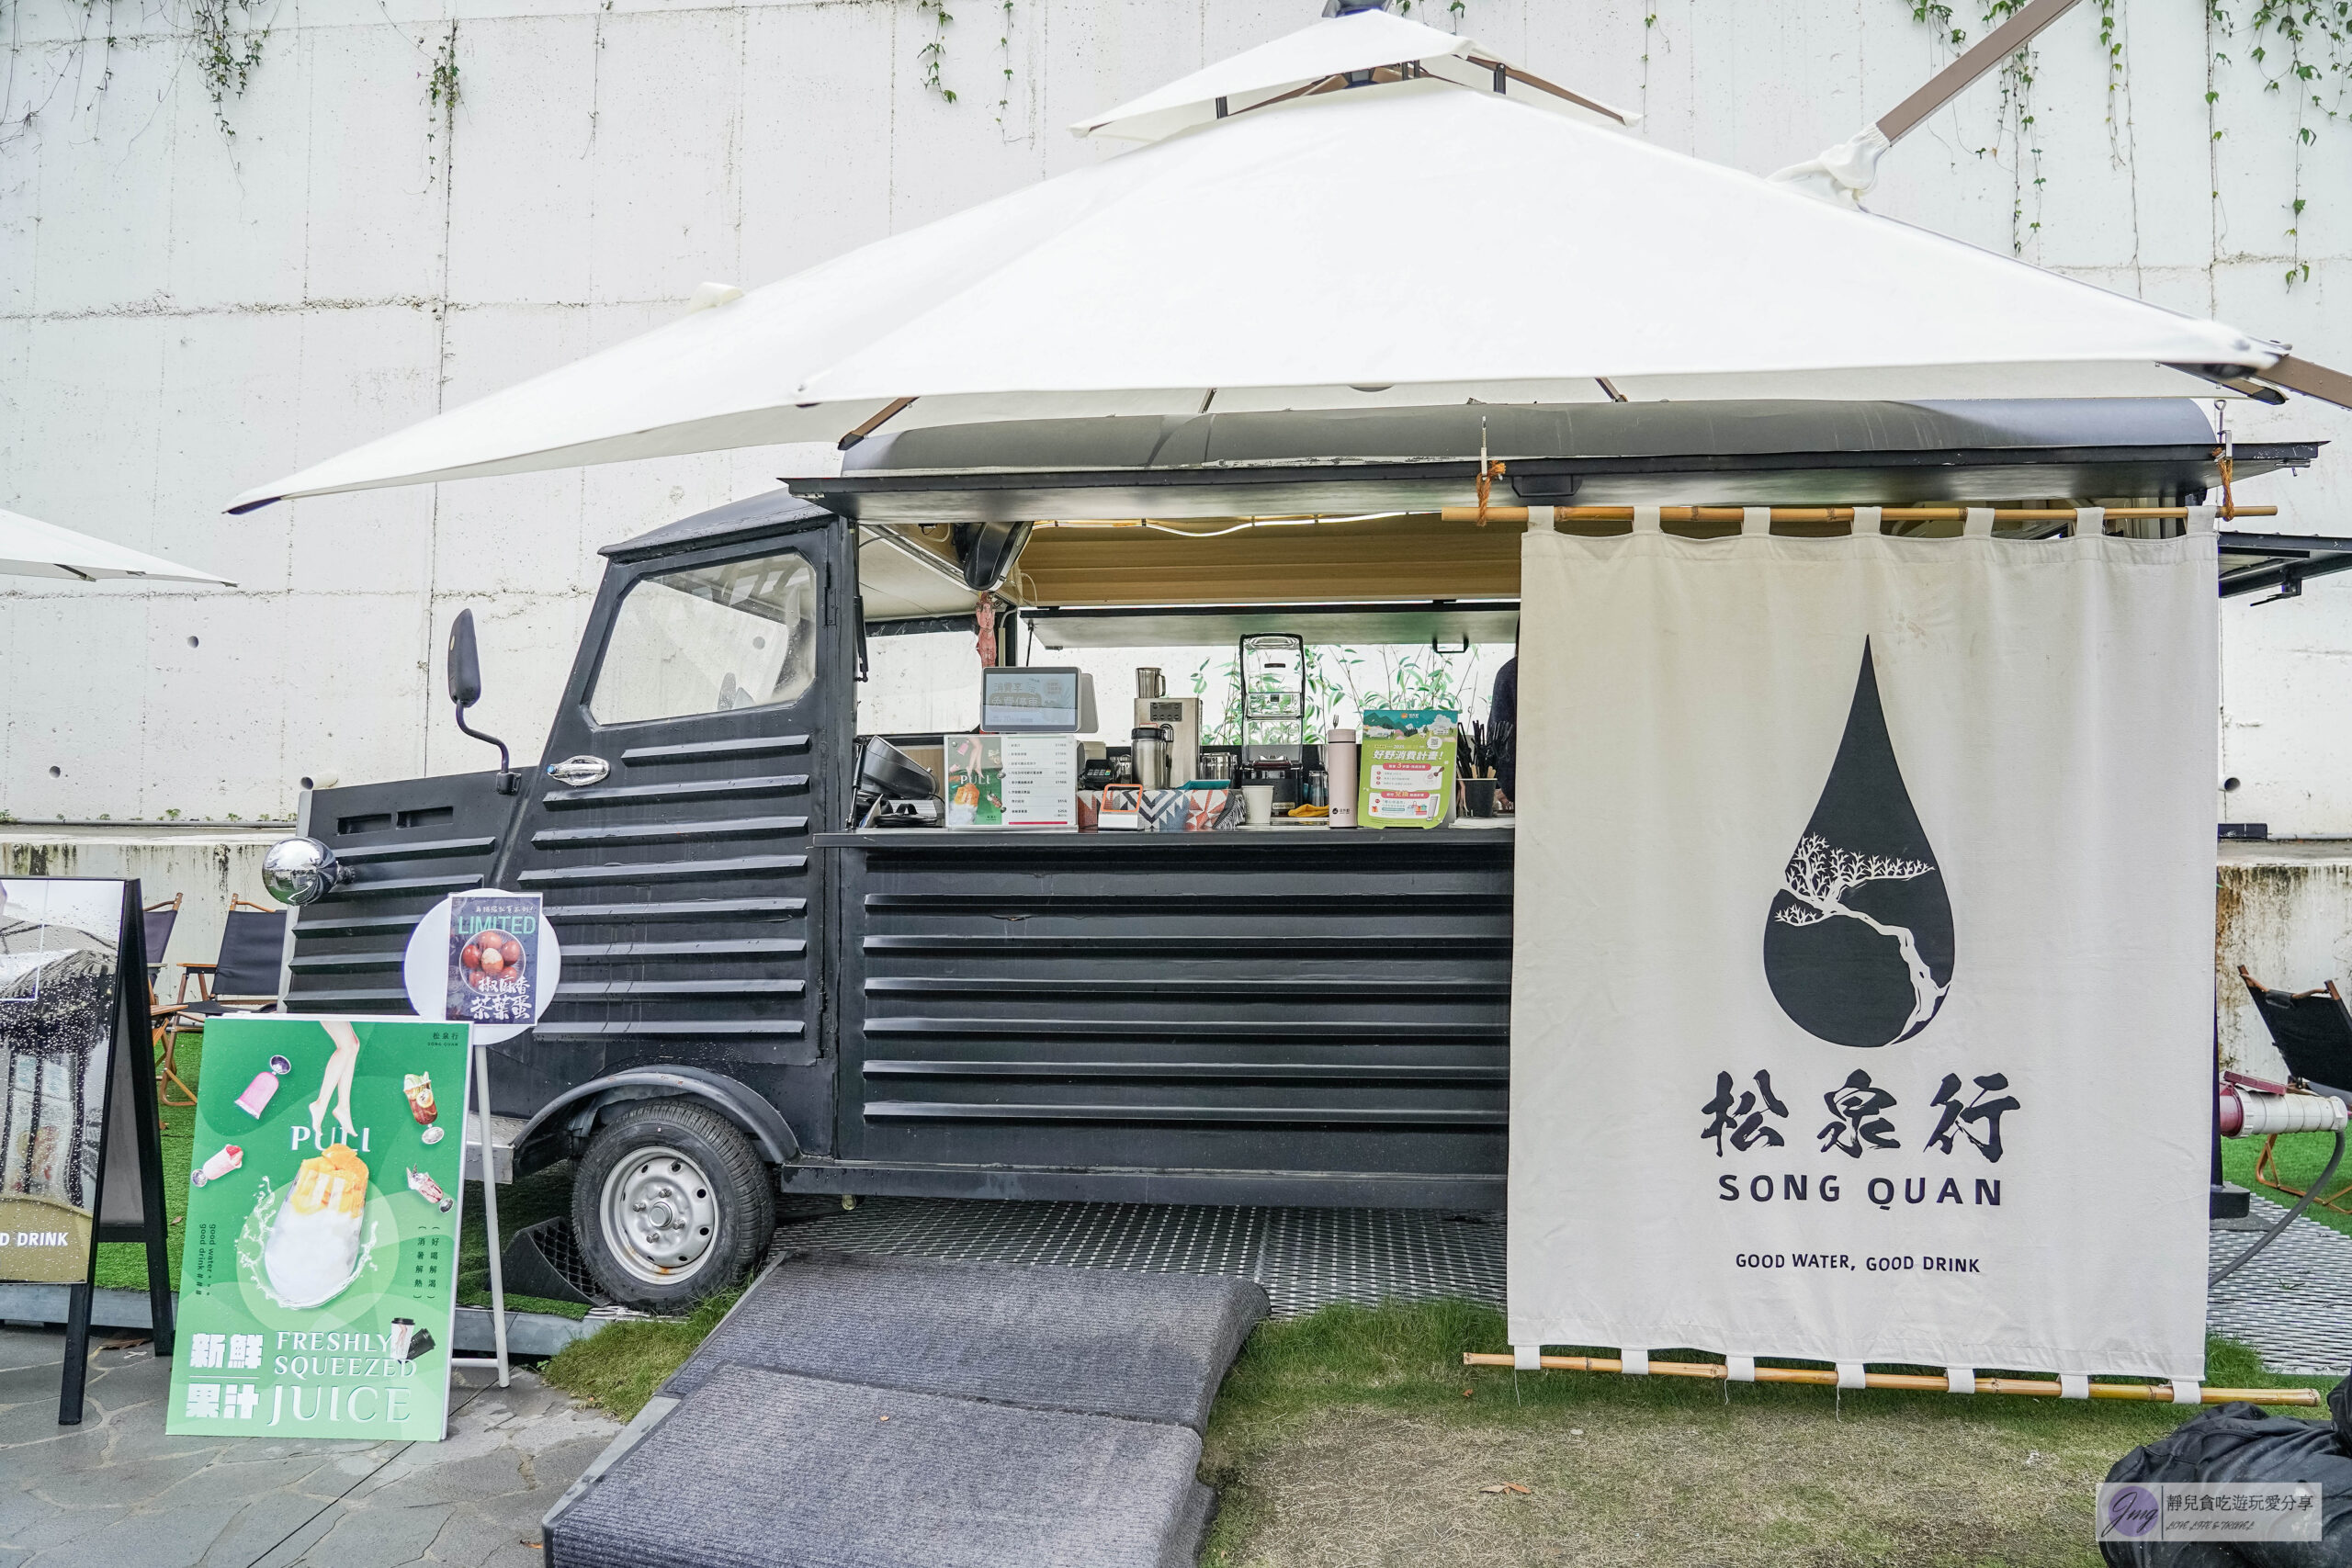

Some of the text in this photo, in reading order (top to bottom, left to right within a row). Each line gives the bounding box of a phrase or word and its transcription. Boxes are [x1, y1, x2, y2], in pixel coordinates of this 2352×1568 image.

[458, 916, 536, 934] LIMITED
[469, 995, 532, 1021] 茶葉蛋
[1700, 1068, 2021, 1164] 松泉行
[1718, 1173, 2002, 1211] SONG QUAN
[17, 1231, 70, 1247] DRINK
[199, 1224, 208, 1245] good
[197, 1247, 207, 1271] drink
[207, 1248, 215, 1273] water
[1736, 1253, 1981, 1273] GOOD WATER, GOOD DRINK
[189, 1333, 264, 1370] 新鮮
[276, 1331, 392, 1353] FRESHLY
[274, 1355, 418, 1380] SQUEEZED
[185, 1383, 261, 1419] 果汁
[266, 1384, 413, 1427] JUICE
